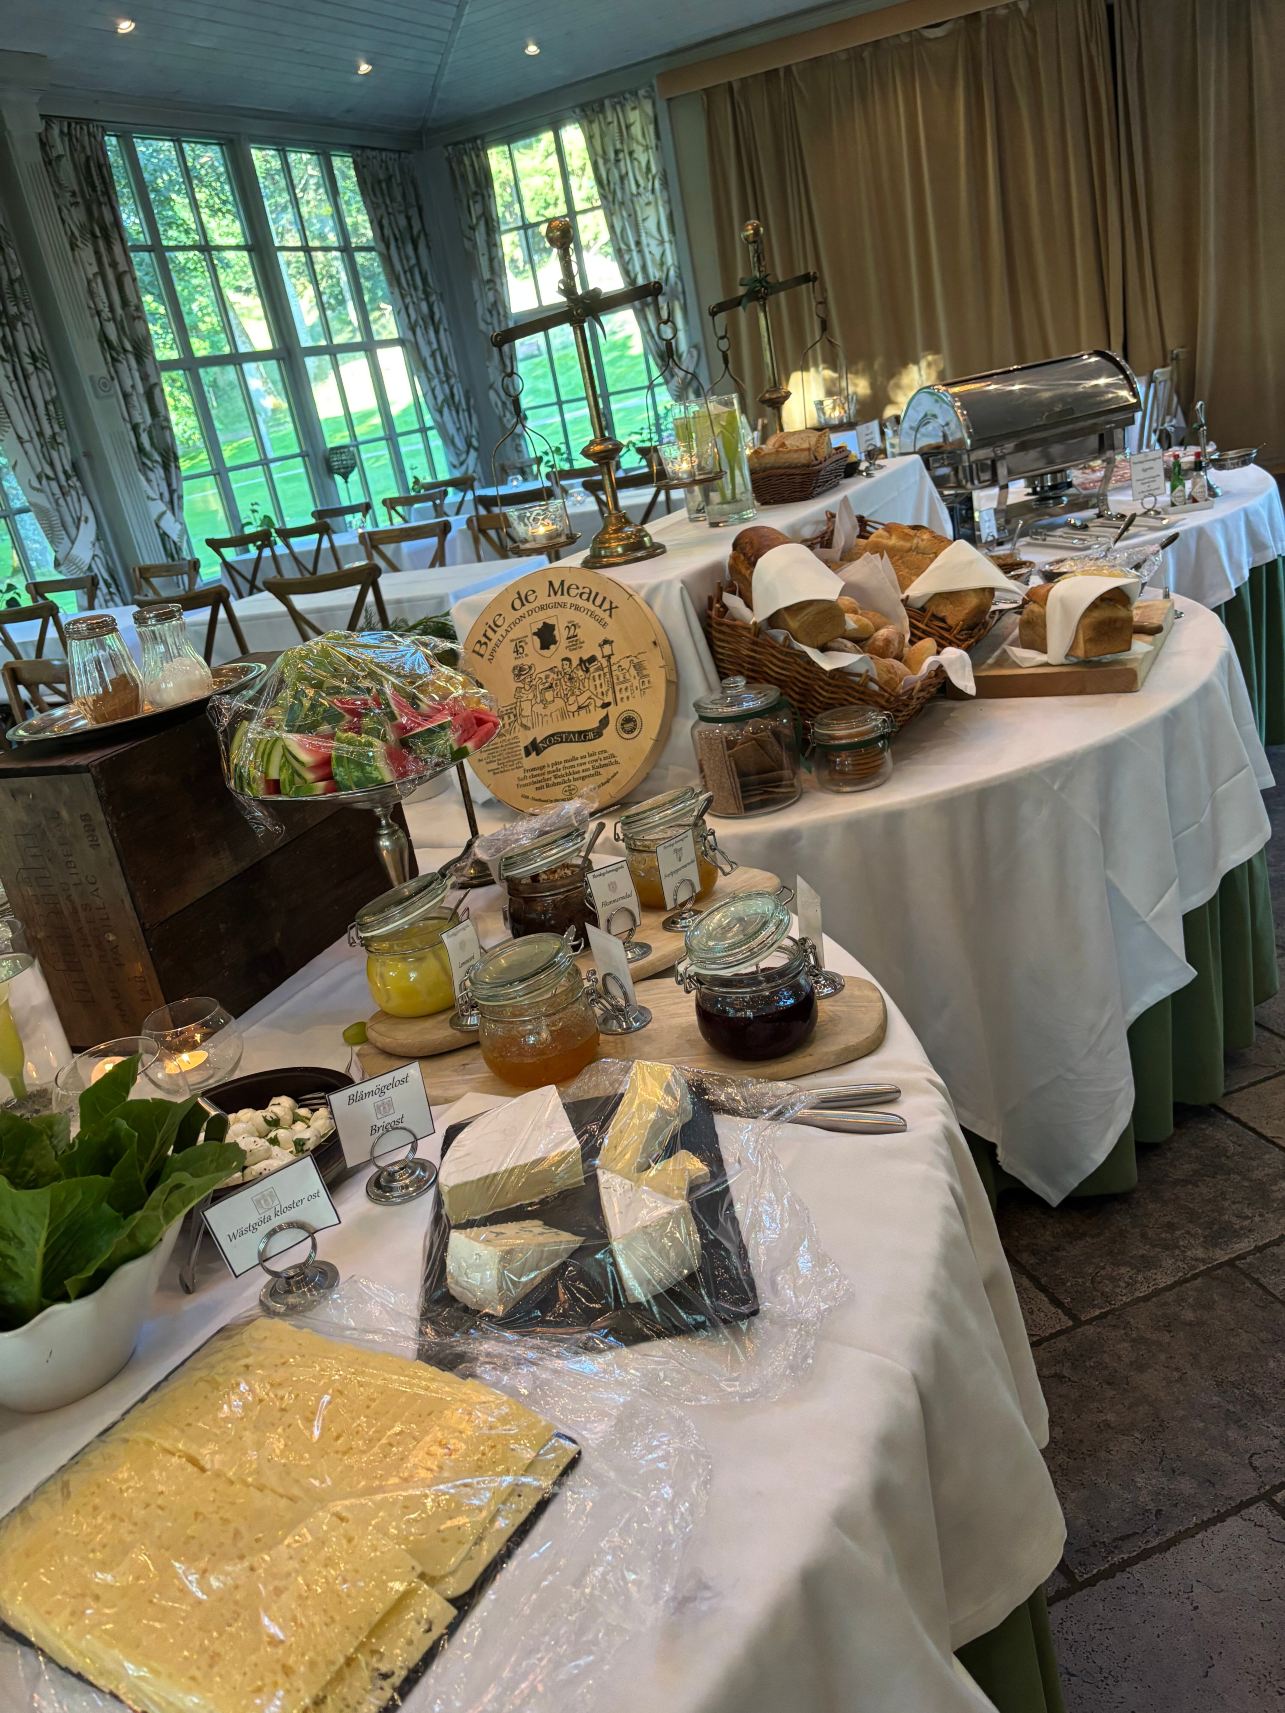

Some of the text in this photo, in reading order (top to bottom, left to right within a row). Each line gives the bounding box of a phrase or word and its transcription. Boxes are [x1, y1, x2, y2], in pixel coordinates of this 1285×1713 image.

[472, 579, 619, 659] Brie de Meaux
[487, 613, 527, 664] APPELLATION
[540, 730, 599, 751] NOSTALGIE
[85, 874, 126, 968] PAILLAC
[347, 1073, 409, 1106] Blåmögelost
[369, 1114, 405, 1137] Brieost
[225, 1189, 321, 1244] Wästgöta kloster ost
